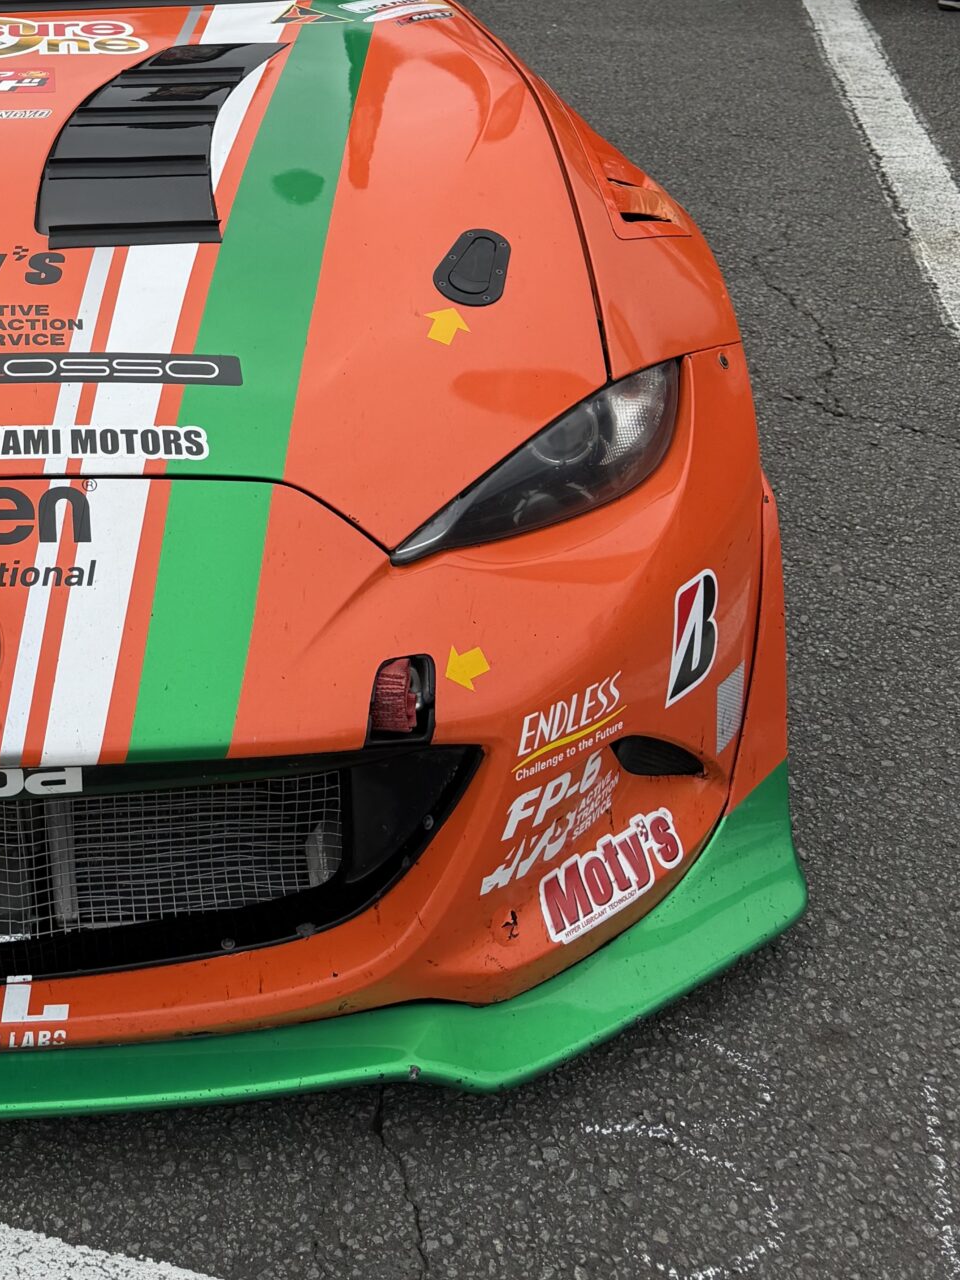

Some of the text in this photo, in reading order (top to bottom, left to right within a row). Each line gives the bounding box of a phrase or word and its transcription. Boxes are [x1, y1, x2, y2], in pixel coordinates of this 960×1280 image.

[70, 425, 208, 458] MOTORS
[517, 671, 622, 758] ENDLESS
[515, 721, 624, 782] Challenge to the Future
[501, 748, 602, 841] FP-6
[576, 771, 620, 824] TRACTION
[578, 769, 613, 812] ACTIVE
[572, 794, 613, 841] SERVICE
[543, 815, 680, 936] Moty's
[564, 889, 639, 938] HYPER LUBRICANT TECHNOLOGY
